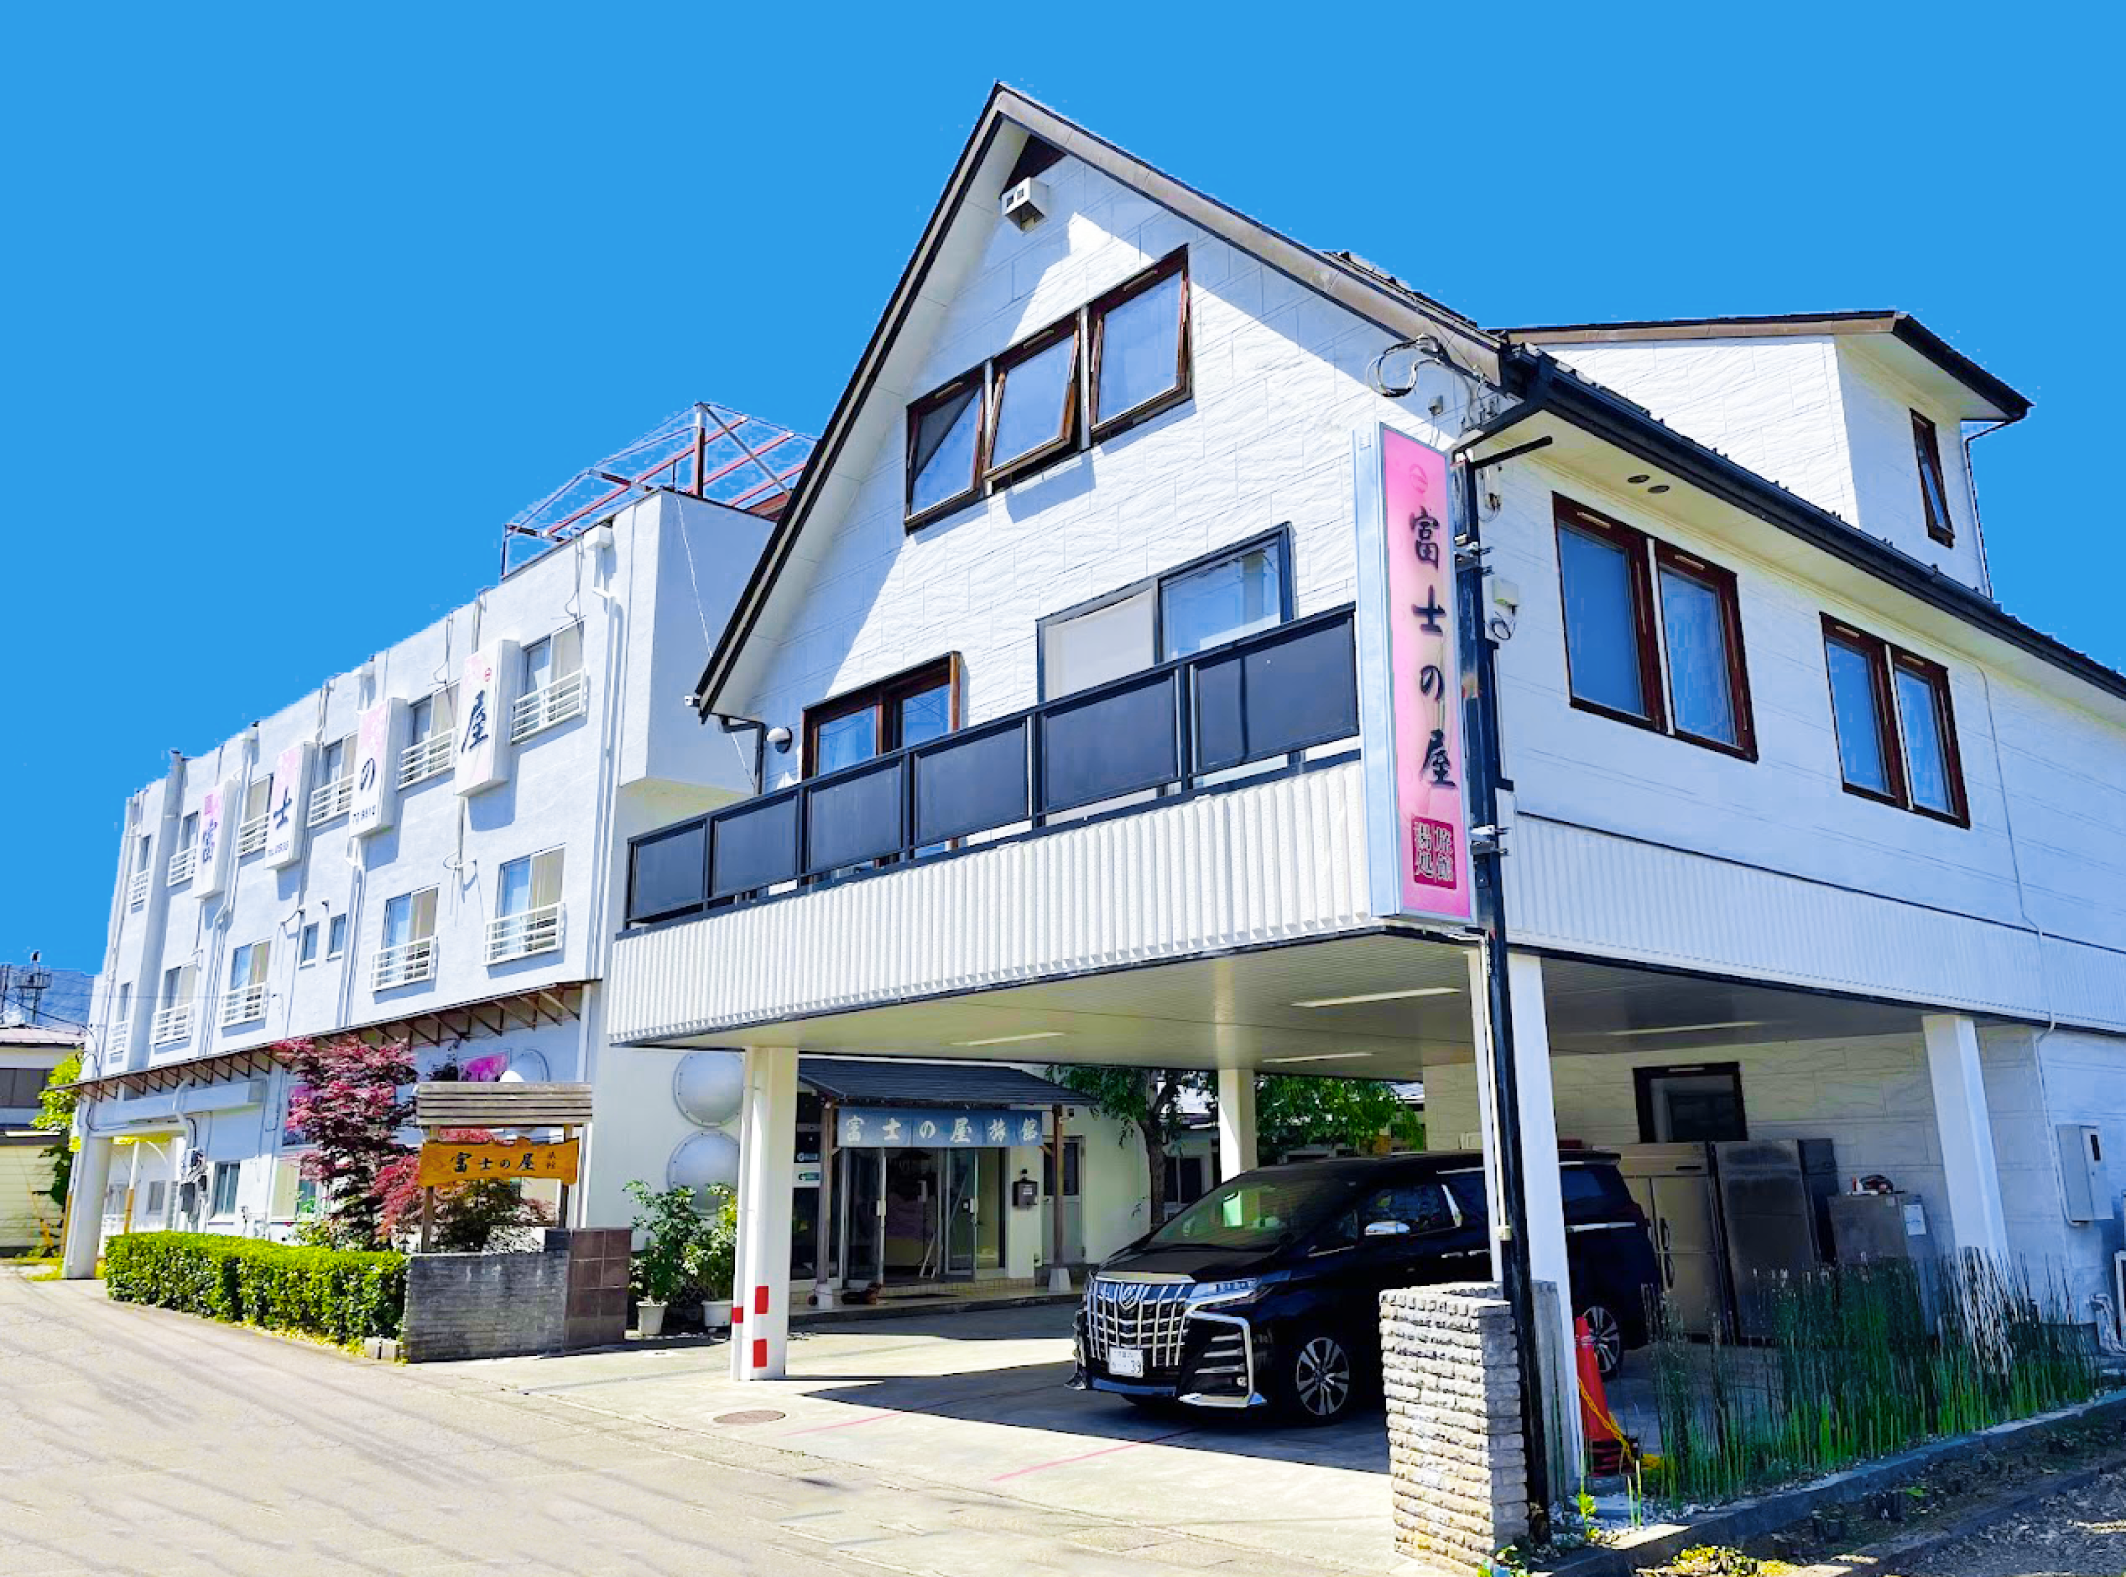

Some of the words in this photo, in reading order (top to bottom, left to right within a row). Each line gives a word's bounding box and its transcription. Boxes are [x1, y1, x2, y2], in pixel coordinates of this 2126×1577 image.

[1409, 505, 1456, 789] 富士の屋
[360, 757, 376, 790] の
[461, 689, 489, 754] 屋
[845, 1115, 1039, 1142] 富士の屋旅館
[450, 1151, 536, 1173] 富士の屋
